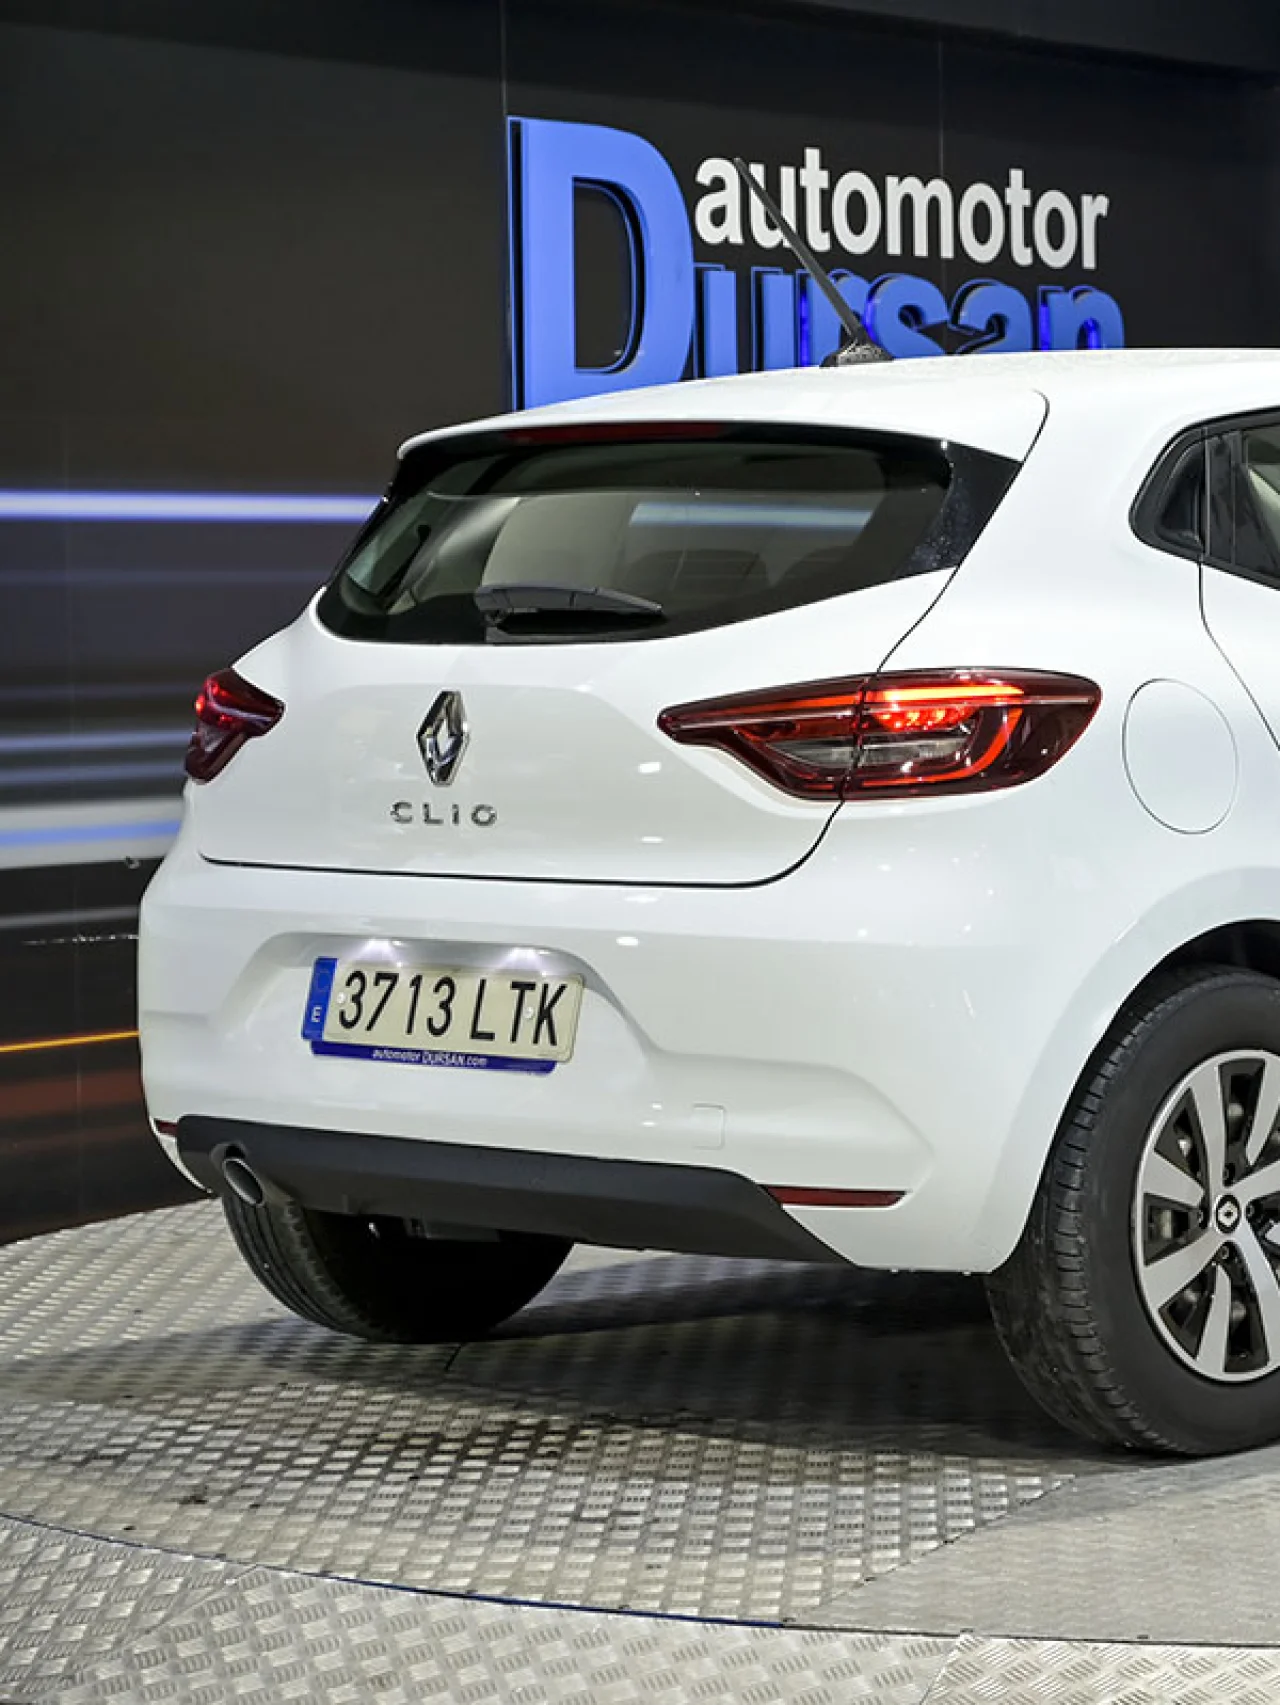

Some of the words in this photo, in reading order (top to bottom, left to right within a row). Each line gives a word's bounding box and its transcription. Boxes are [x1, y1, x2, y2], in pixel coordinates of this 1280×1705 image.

[695, 147, 1110, 270] automotor
[390, 800, 497, 826] CLIO
[311, 1006, 323, 1022] E
[338, 970, 456, 1037] 3713
[470, 978, 568, 1046] LTK
